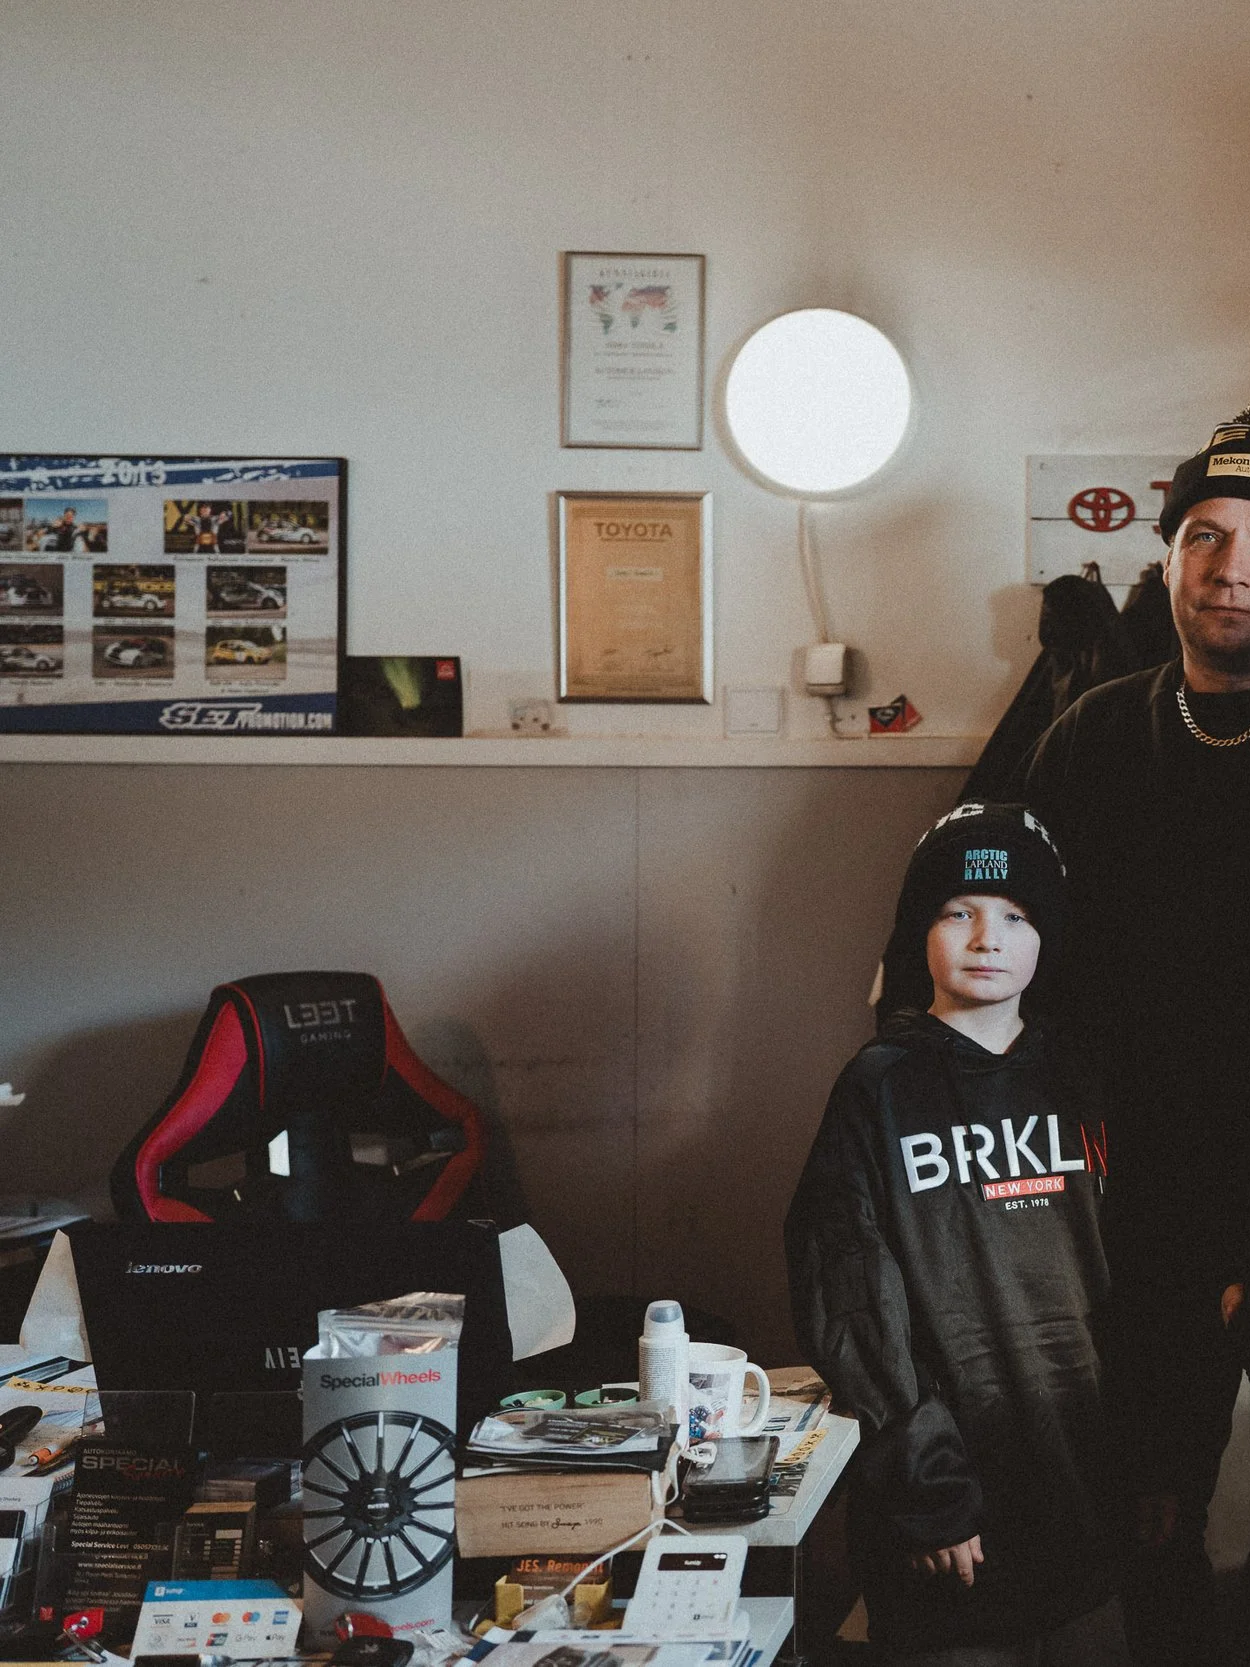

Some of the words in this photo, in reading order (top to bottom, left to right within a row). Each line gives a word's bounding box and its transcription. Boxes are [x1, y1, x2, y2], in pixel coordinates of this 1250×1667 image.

[594, 522, 673, 538] TOYOTA
[965, 848, 1008, 861] ARCTIC
[965, 859, 1008, 870] LAPLAND
[964, 868, 1008, 881] RALLY
[985, 1183, 1021, 1199] NEW
[1027, 1178, 1063, 1192] YORK
[1004, 1200, 1028, 1211] EST.
[1031, 1198, 1050, 1208] 1978
[125, 1261, 202, 1274] lenovo
[82, 1455, 179, 1471] SPECIAL
